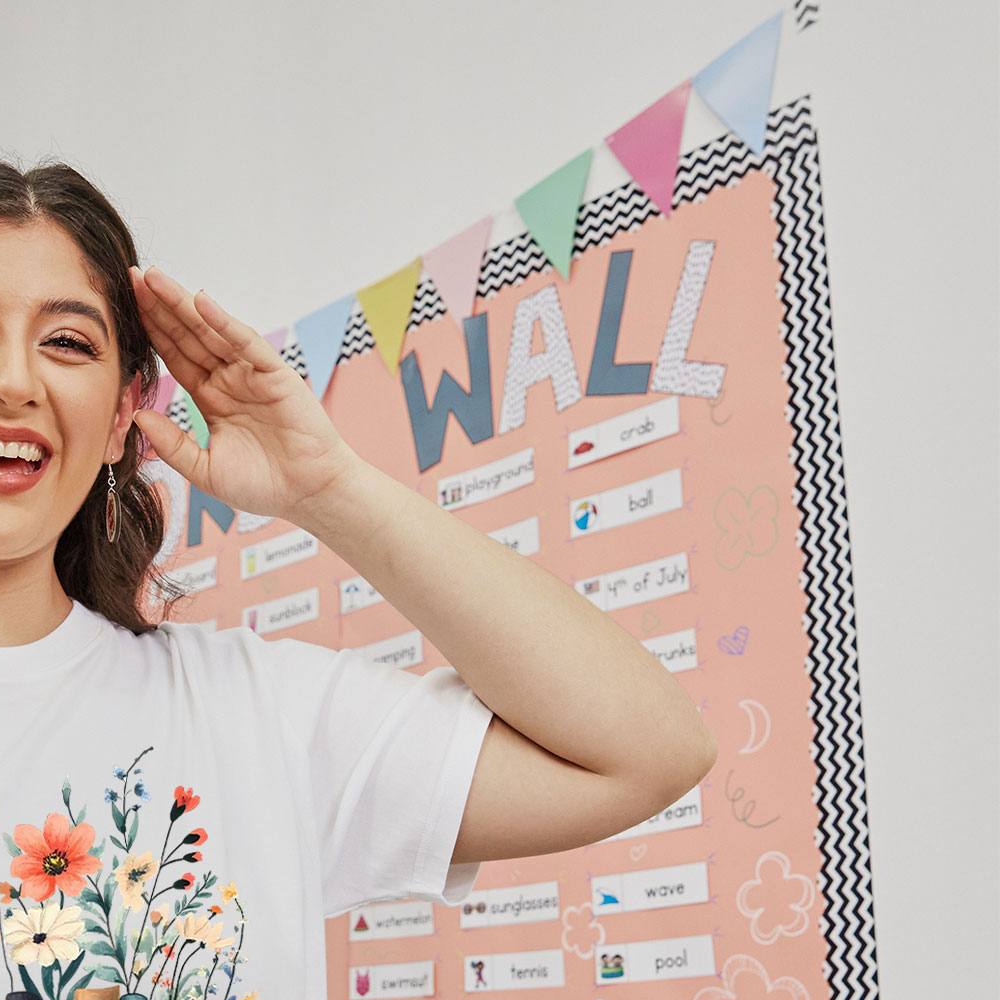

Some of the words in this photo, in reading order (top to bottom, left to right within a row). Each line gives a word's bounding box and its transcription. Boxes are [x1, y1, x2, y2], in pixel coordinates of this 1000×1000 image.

[399, 239, 728, 473] WALL
[620, 415, 655, 442] crab
[465, 454, 535, 496] playground
[628, 489, 654, 512] ball
[266, 540, 313, 562] lemonade
[633, 573, 650, 594] of
[657, 565, 689, 587] July
[645, 880, 685, 899] wave
[490, 895, 559, 917] sunglasses
[375, 911, 432, 929] watermelon
[656, 949, 688, 973] pool
[511, 965, 549, 981] tennis
